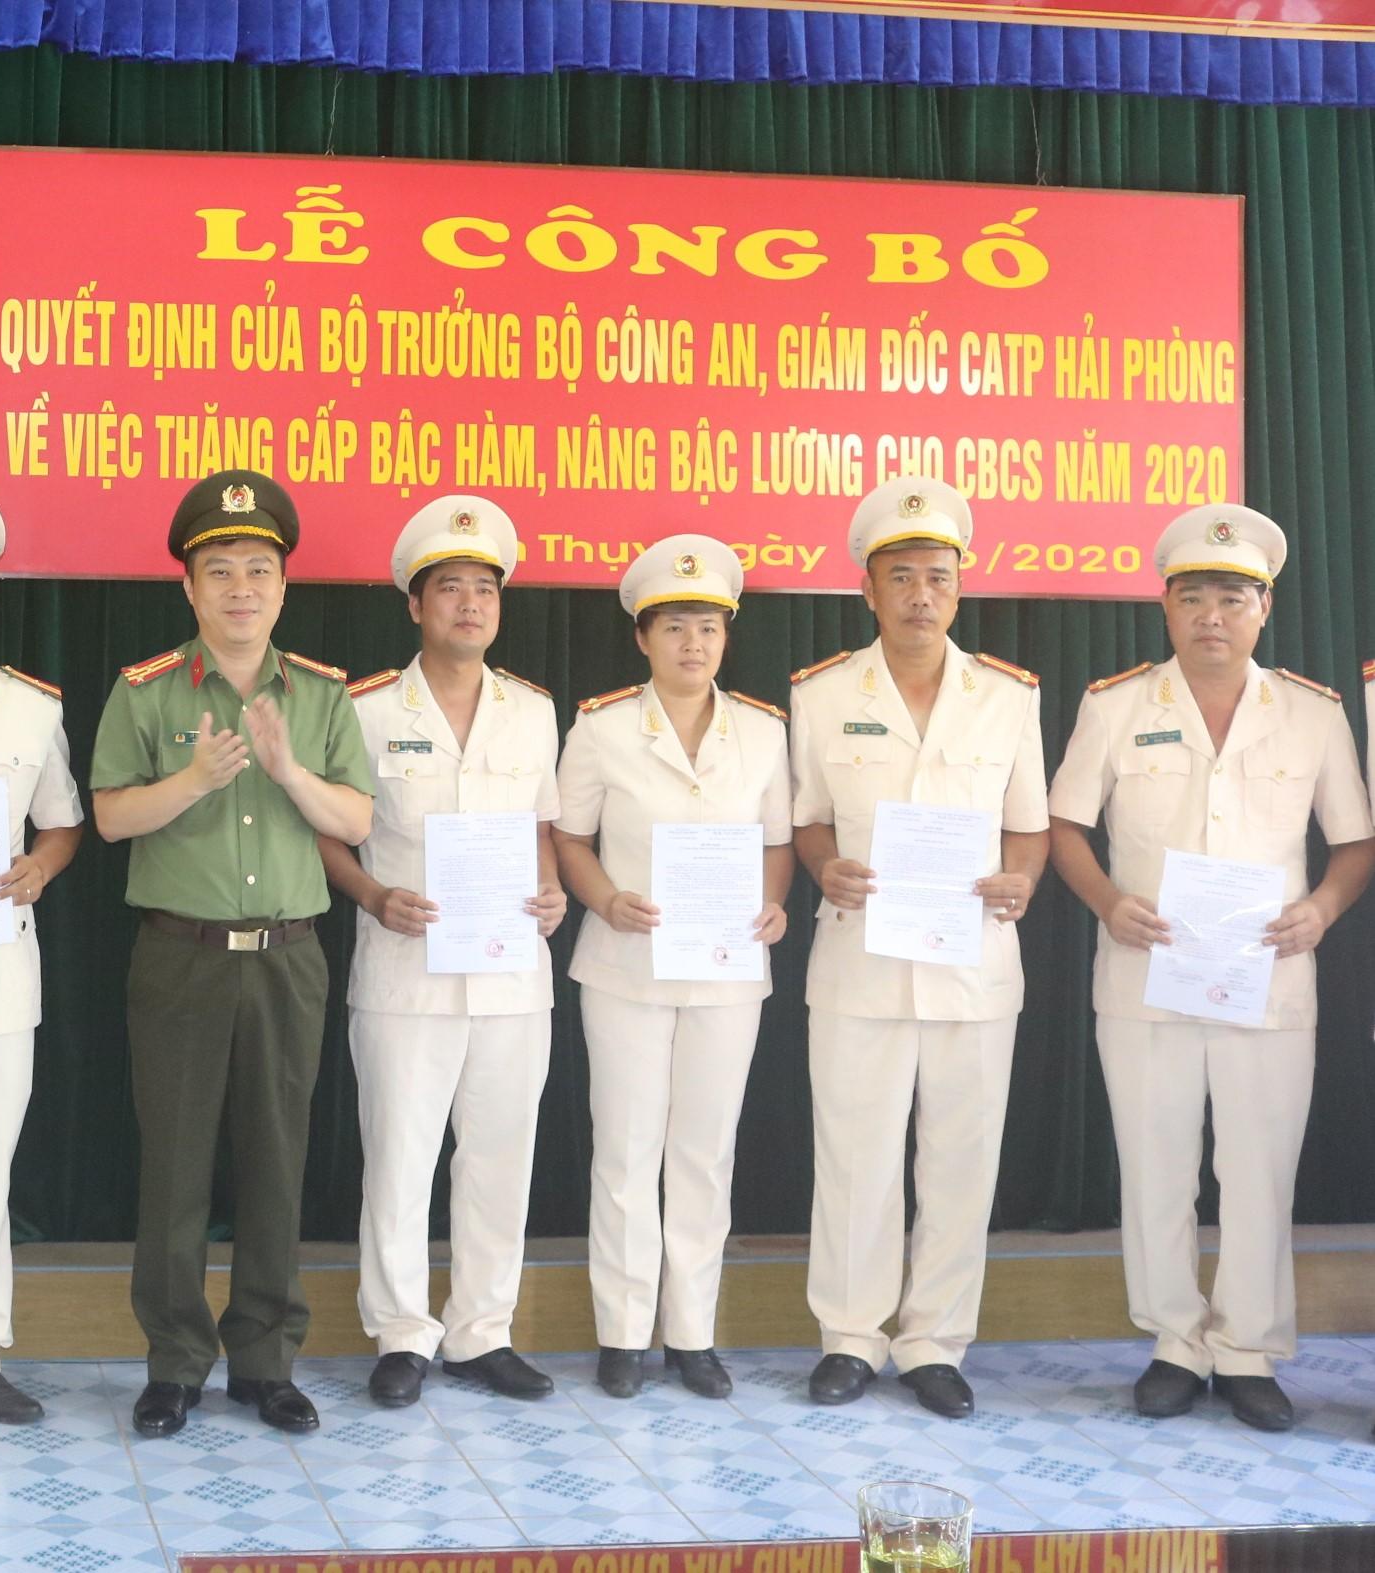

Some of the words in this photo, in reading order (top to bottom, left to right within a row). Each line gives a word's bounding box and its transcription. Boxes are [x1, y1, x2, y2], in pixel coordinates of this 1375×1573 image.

[195, 184, 369, 265] LỄ
[422, 204, 828, 281] CÔNG
[866, 207, 1049, 289] BỐ
[0, 281, 115, 374] QUYẾT
[127, 302, 216, 381] ĐỊNH
[231, 279, 304, 372] CỦA
[320, 293, 368, 388] BỘ
[377, 287, 521, 380] TRƯỞNG
[536, 302, 583, 393] BỘ
[596, 304, 694, 385] CÔNG
[707, 322, 768, 397] AN,
[777, 312, 866, 392] GIÁM
[879, 310, 949, 395] ĐỐC
[959, 331, 1045, 398] CATP
[1055, 312, 1110, 401] HẢI
[1122, 325, 1235, 405] PHÒNG
[6, 391, 50, 476] VỀ
[62, 400, 143, 490] VIỆC
[155, 402, 274, 479] THĂNG
[287, 398, 358, 483] CẤP
[370, 406, 441, 498] BẬC
[455, 408, 547, 497] HÀM,
[556, 413, 656, 492] NÂNG
[670, 416, 738, 506] BẬC
[752, 425, 864, 498] LƯƠNG
[876, 433, 944, 487] CHO
[954, 435, 1043, 503] CBCS
[1054, 427, 1131, 504] NĂM
[1144, 443, 1227, 506] 2020
